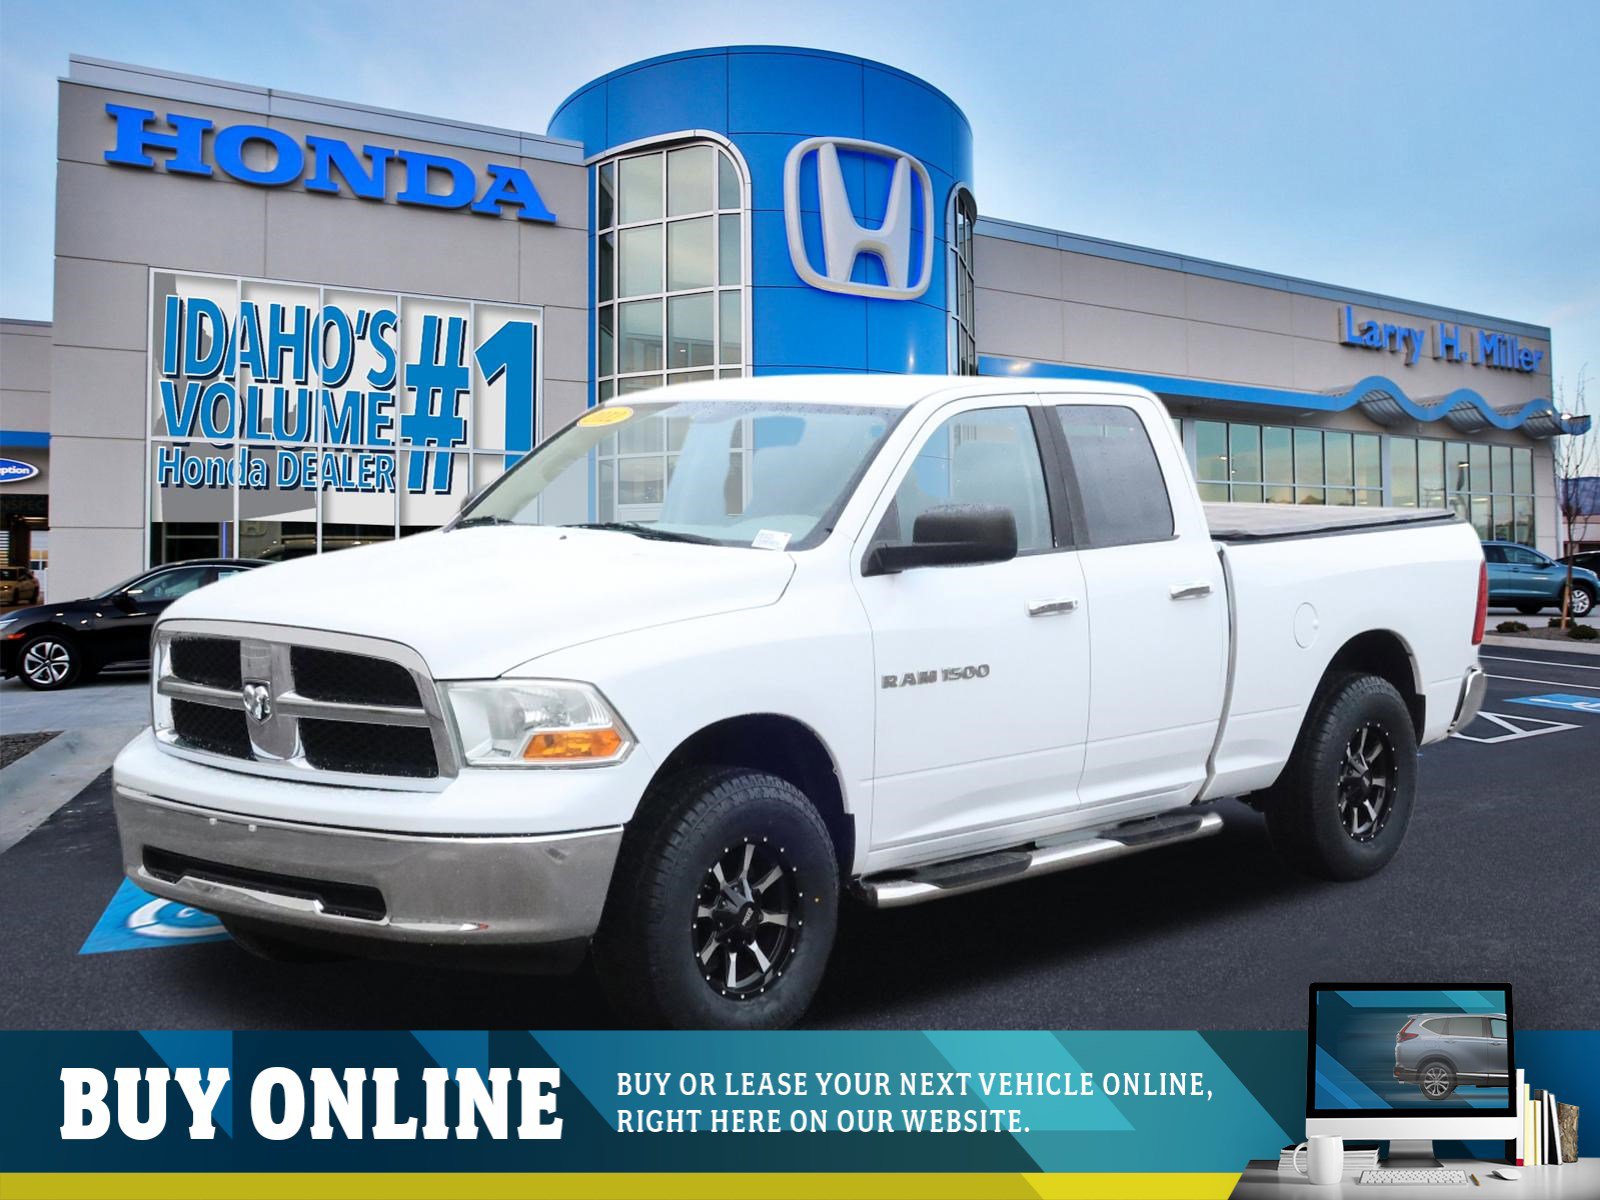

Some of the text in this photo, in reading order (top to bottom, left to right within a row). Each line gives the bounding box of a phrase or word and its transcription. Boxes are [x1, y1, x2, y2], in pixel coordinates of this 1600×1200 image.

[104, 103, 557, 223] HONDA
[162, 295, 400, 389] IDAHO'S
[1342, 305, 1546, 373] Larry H. Miller
[158, 379, 396, 449] VOLUME
[0, 466, 30, 476] ption
[156, 446, 396, 492] Honda DEALER
[881, 663, 990, 689] RAM 1500
